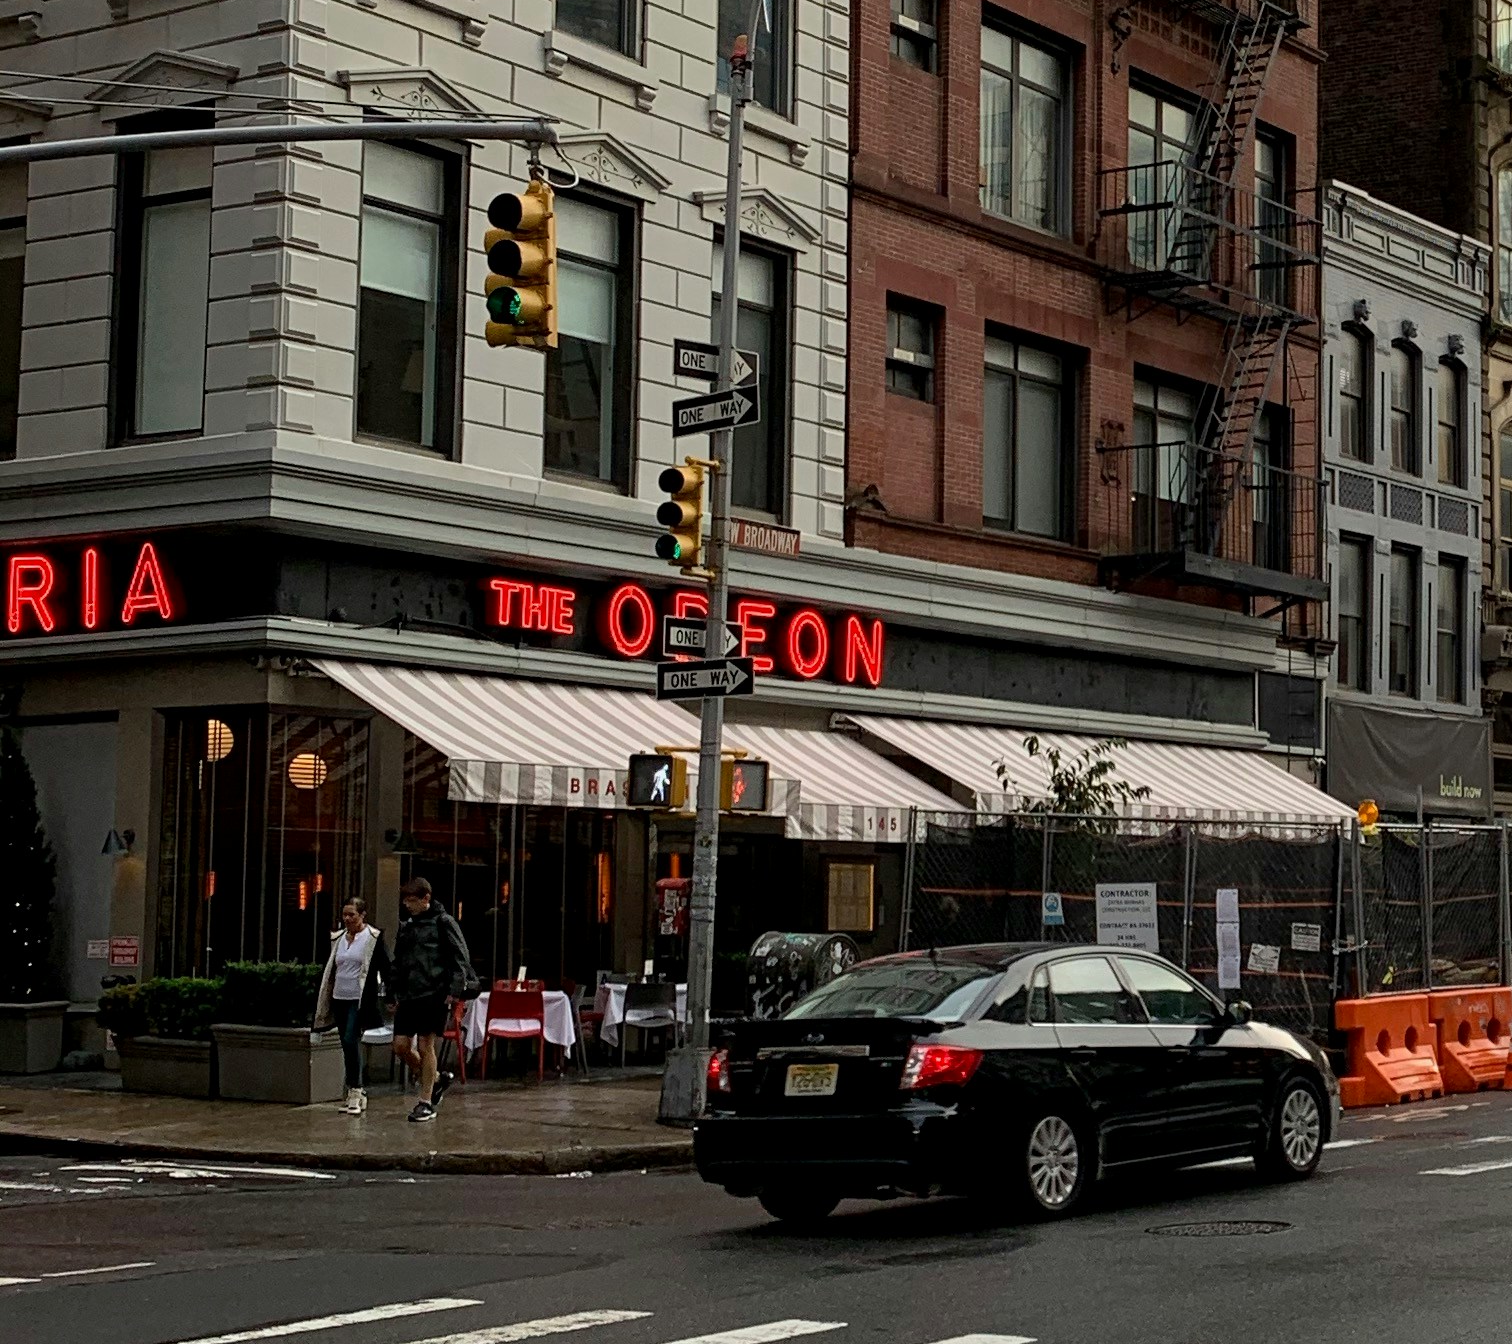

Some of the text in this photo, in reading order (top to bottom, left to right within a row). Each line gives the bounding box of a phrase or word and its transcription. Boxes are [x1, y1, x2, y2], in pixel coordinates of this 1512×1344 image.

[682, 352, 705, 368] ONE
[680, 399, 744, 425] ONE WAY
[744, 525, 798, 555] BROADWAY
[8, 542, 171, 633] RIA
[490, 579, 576, 635] THE
[676, 629, 698, 645] ONE
[670, 670, 738, 688] ONE WAY
[1440, 774, 1482, 799] build now
[866, 816, 897, 832] 145
